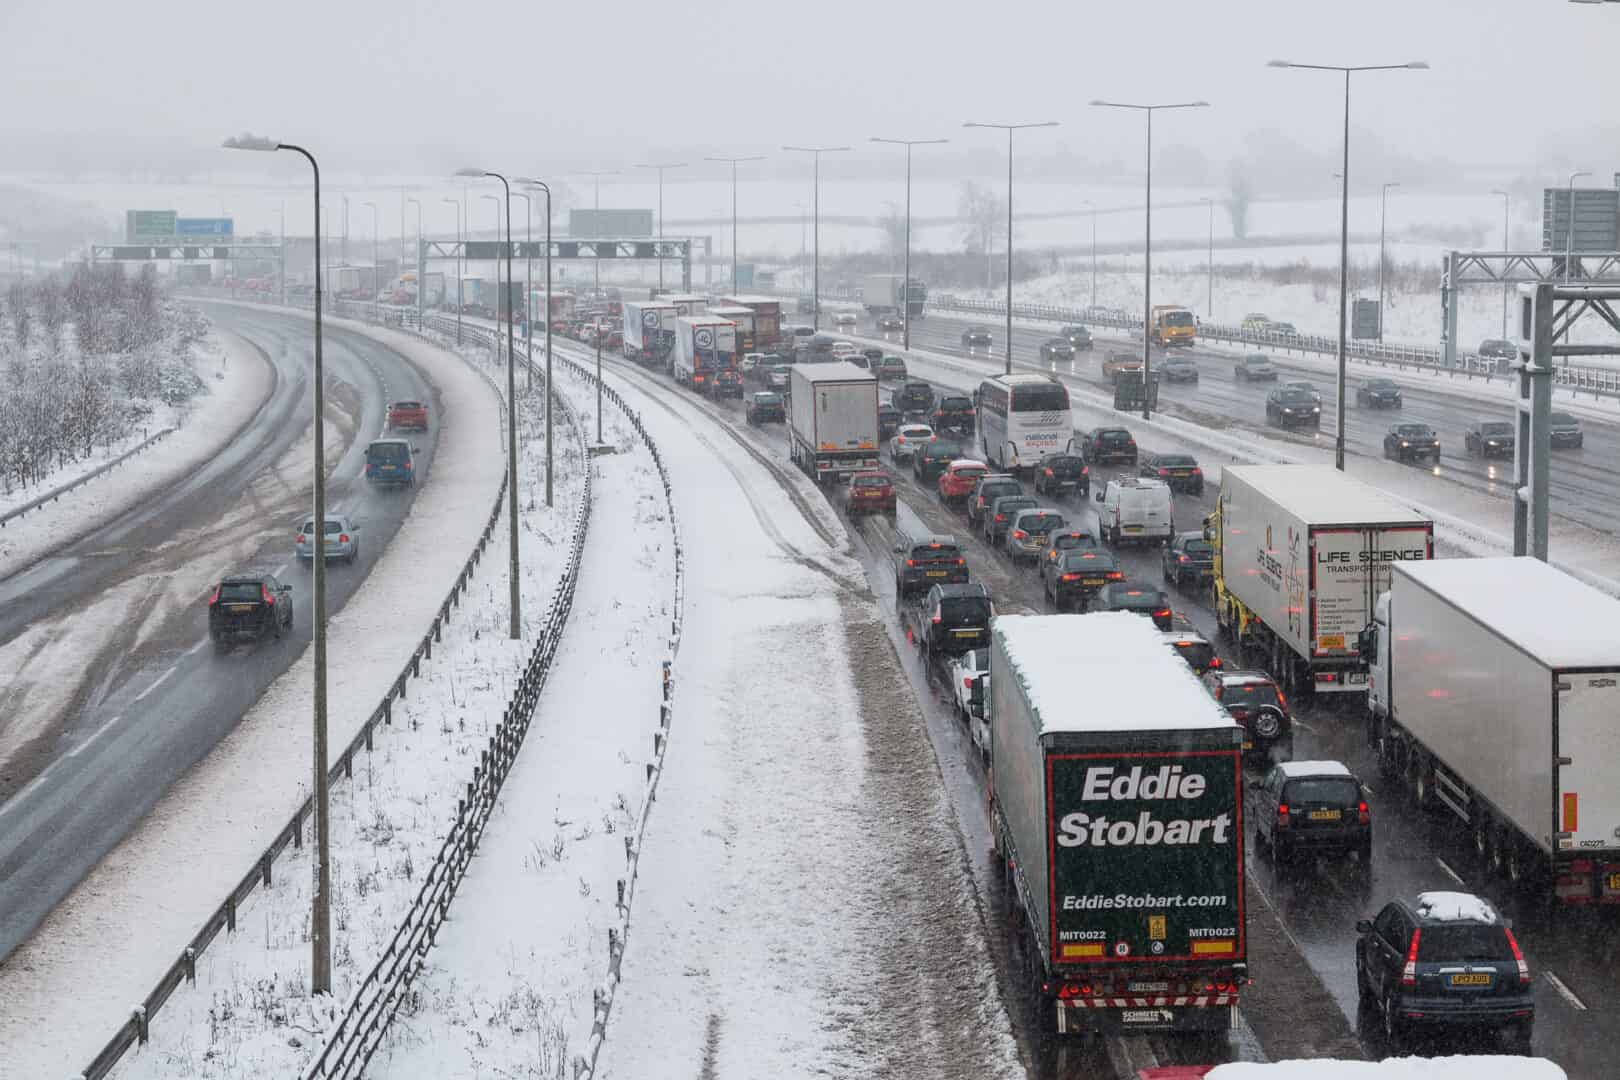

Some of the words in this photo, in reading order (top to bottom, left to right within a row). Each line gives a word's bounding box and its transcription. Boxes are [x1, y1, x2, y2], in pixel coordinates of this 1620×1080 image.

[1318, 551, 1350, 562] LIFE
[1359, 550, 1424, 562] SCIENCE
[1081, 765, 1206, 801] Eddie
[1057, 811, 1231, 847] Stobart
[1063, 893, 1227, 910] EddieStobart.com
